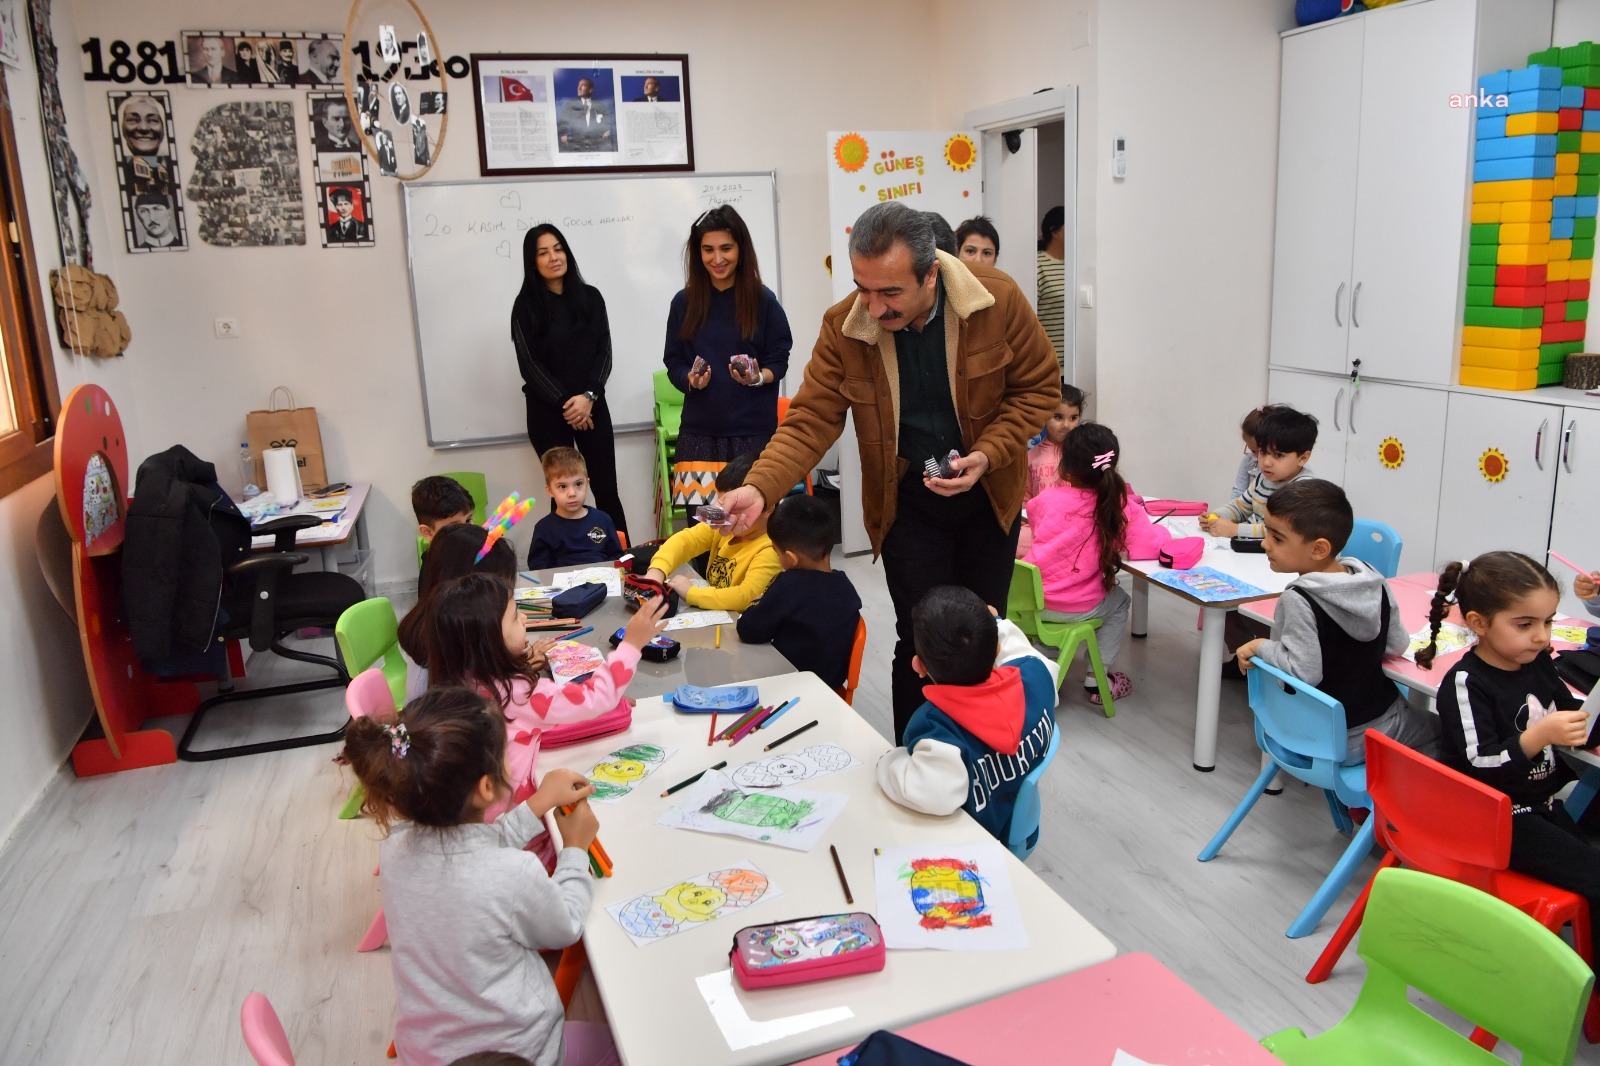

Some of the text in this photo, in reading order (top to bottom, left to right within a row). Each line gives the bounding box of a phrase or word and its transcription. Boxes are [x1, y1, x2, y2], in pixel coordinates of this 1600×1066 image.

[81, 37, 186, 84] 1881
[873, 151, 924, 175] GÜNEŞ
[877, 182, 922, 202] SINIFI
[424, 213, 452, 236] 20
[467, 220, 506, 235] KASIM
